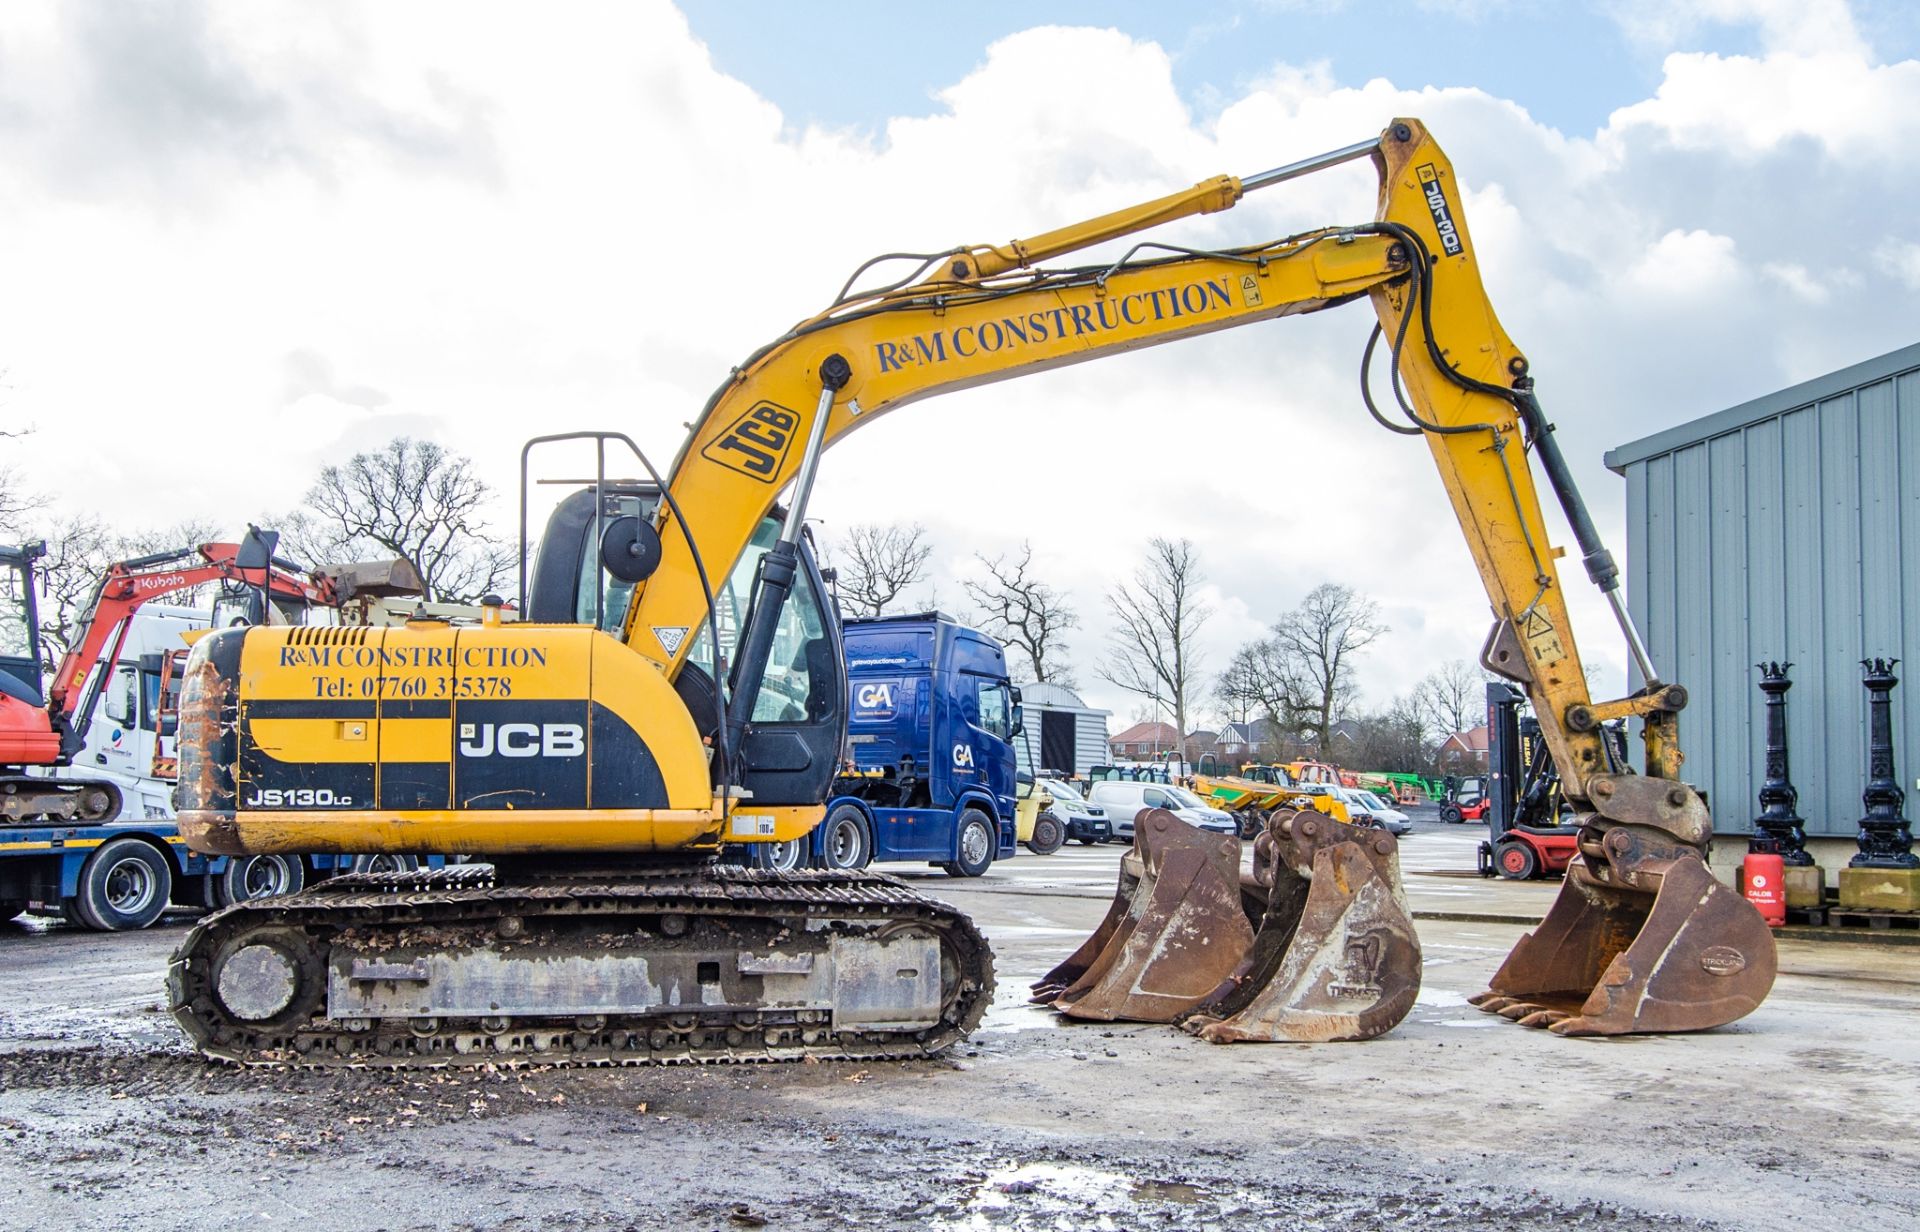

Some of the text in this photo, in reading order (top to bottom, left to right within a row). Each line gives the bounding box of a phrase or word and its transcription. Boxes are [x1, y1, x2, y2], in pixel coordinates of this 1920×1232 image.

[874, 277, 1233, 373] R&M CONSTRUCTION
[717, 406, 794, 475] JCB
[141, 575, 185, 589] Kubota
[280, 646, 547, 668] R&M CONSTRUCTION
[851, 658, 907, 667] gatewayauctions.com
[312, 676, 512, 697] Tel: 07760 325378
[858, 684, 893, 708] GA
[460, 723, 585, 758] JCB
[952, 744, 975, 768] GA
